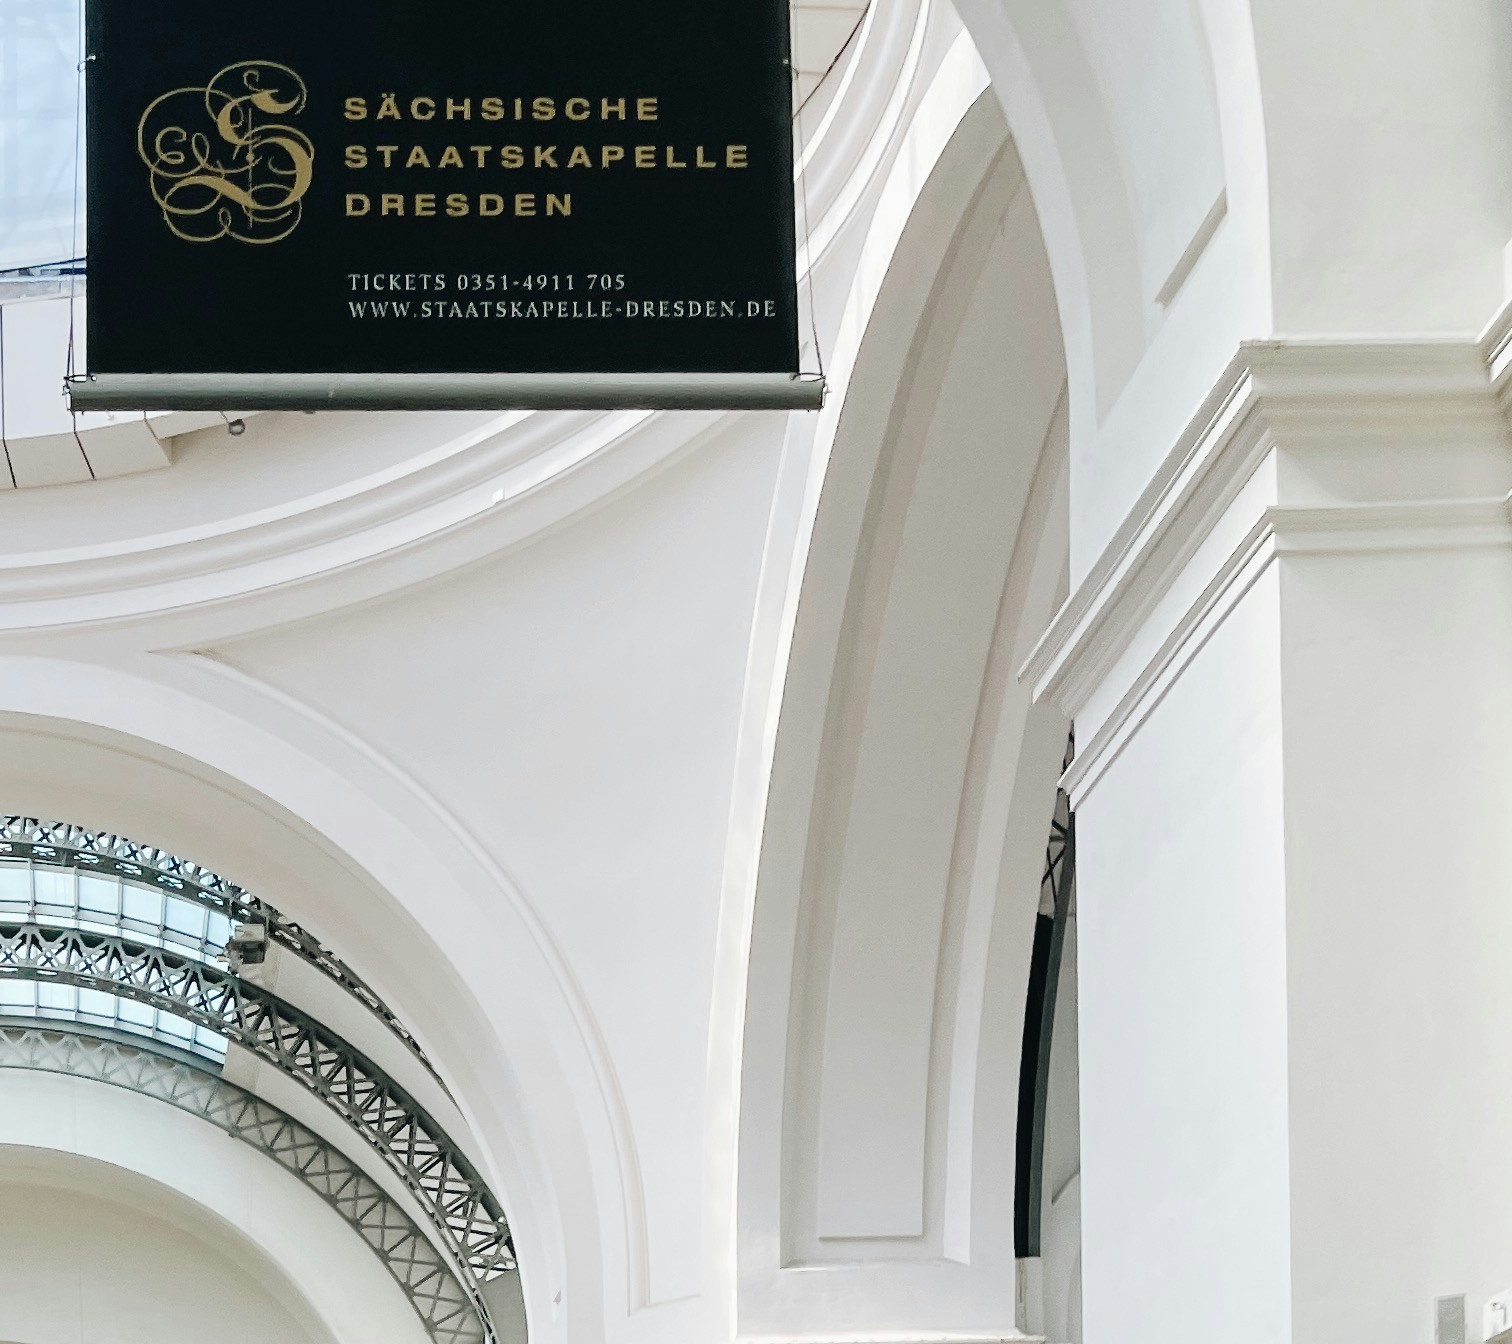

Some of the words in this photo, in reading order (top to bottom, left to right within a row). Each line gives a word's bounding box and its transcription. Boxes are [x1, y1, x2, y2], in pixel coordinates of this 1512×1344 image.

[344, 92, 659, 121] SÄCHSISCHE
[344, 144, 749, 170] STAATSKAPELLE
[345, 193, 573, 217] DRESDEN
[347, 273, 446, 291] TICKETS
[457, 273, 575, 291] 0351-4911
[586, 273, 626, 291] 705
[348, 300, 777, 319] WWW.STAATSKAPELLE-DRESDEN.DE
